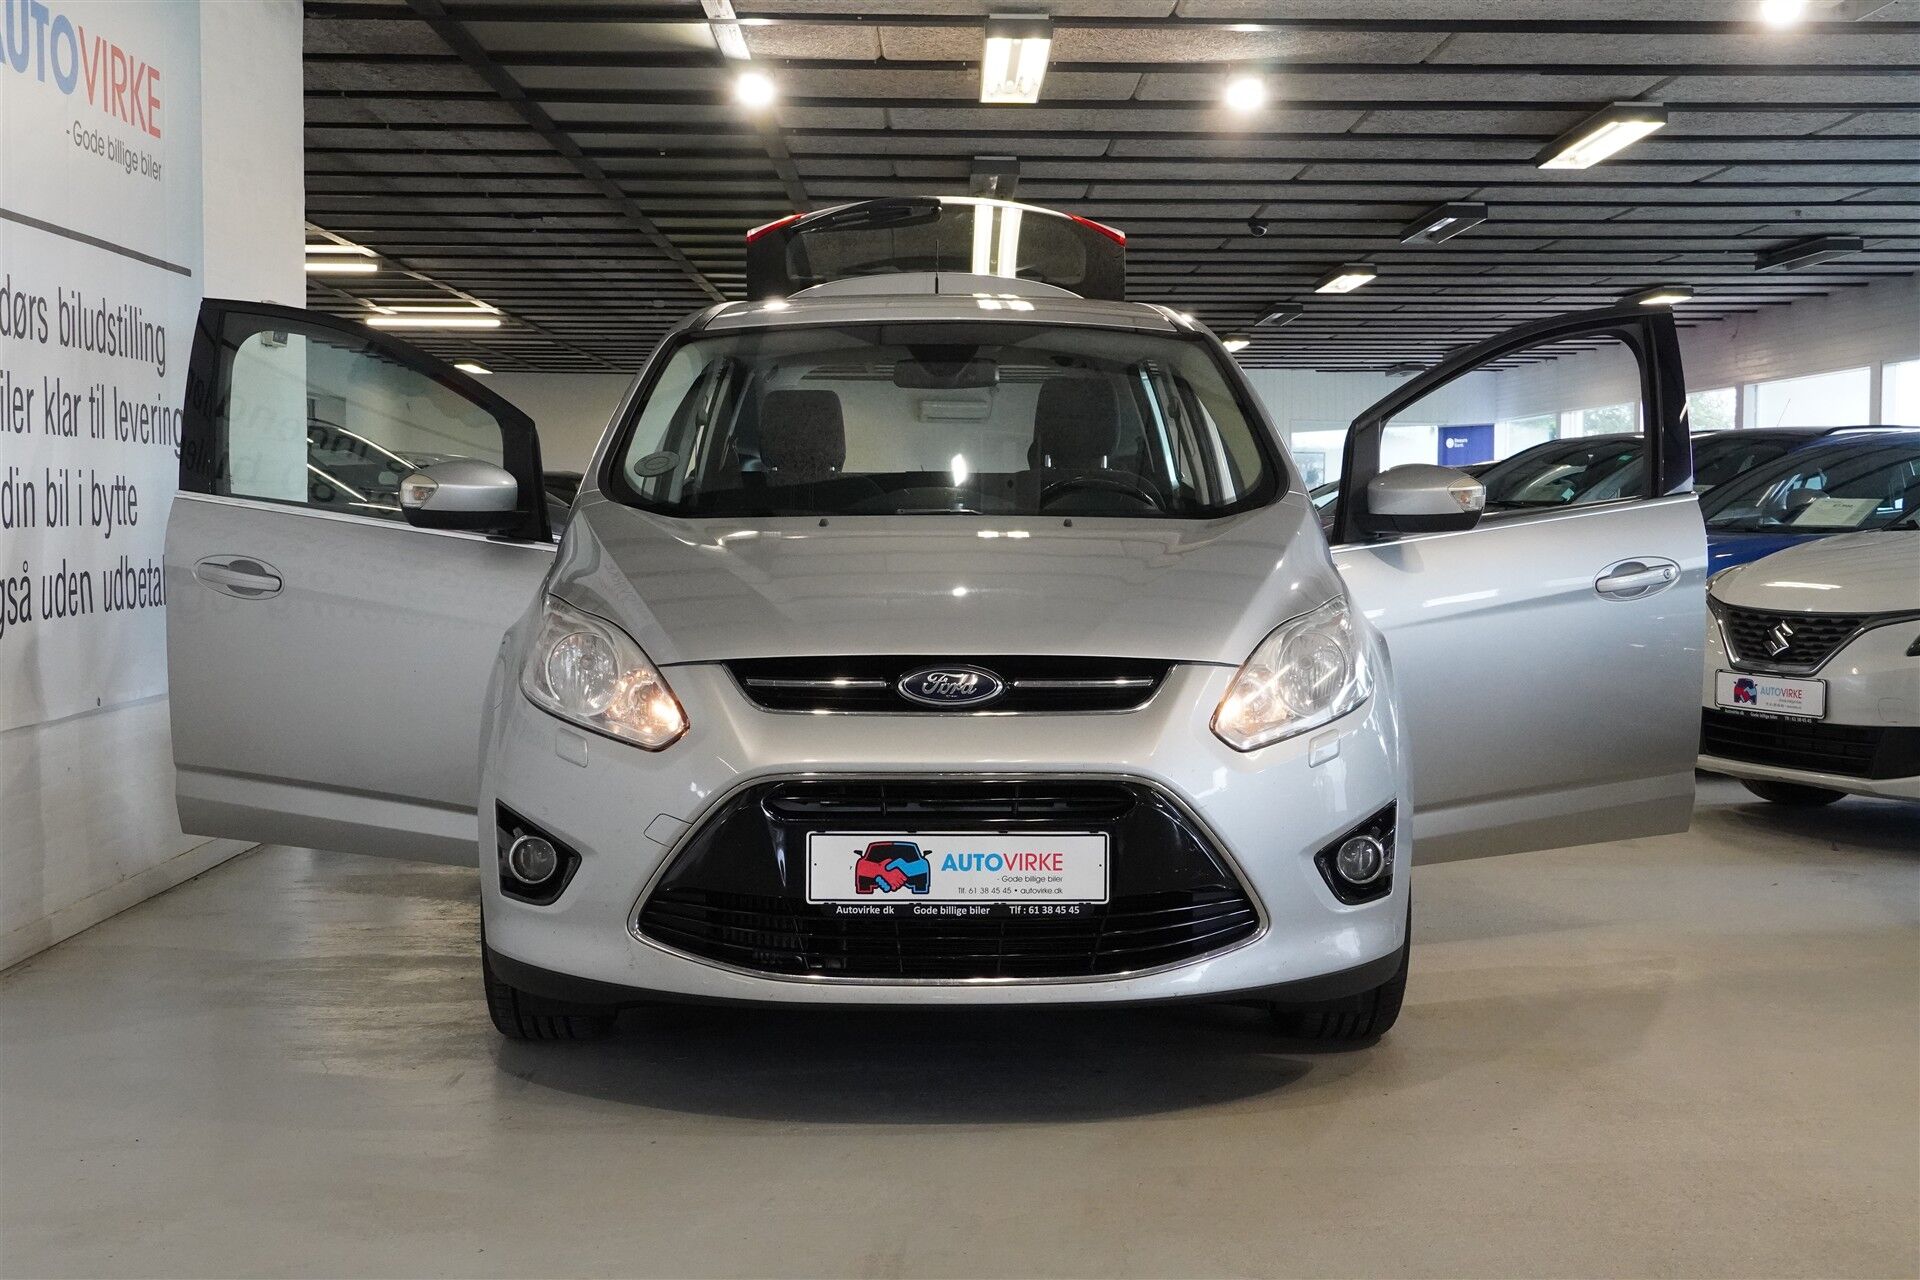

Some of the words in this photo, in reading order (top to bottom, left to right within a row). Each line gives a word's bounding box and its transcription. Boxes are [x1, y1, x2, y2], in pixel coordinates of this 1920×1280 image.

[0, 0, 161, 139] UTOVIRKE
[73, 120, 105, 157] Gode
[107, 135, 139, 175] billige
[141, 150, 162, 182] biler
[0, 273, 49, 344] dørs
[58, 286, 166, 378] biludstilling
[44, 375, 82, 438] klar
[89, 383, 105, 440] til
[114, 386, 184, 460] levering
[2, 466, 36, 529] din
[46, 467, 69, 528] bil
[78, 469, 83, 527] i
[91, 469, 138, 540] bytte
[42, 558, 94, 620] uden
[921, 672, 978, 694] Ford
[1760, 686, 1802, 699] AUTOVIRKE
[941, 853, 1063, 872] AUTOVIRKE
[1001, 875, 1024, 883] Gode
[1025, 875, 1046, 884] billige
[1048, 875, 1063, 883] biler
[836, 905, 880, 915] Autovirke
[882, 905, 895, 915] dk
[913, 905, 938, 915] Gode
[940, 905, 968, 917] billige
[970, 905, 991, 915] biler
[1009, 905, 1022, 915] Tlf
[1028, 905, 1040, 915] 61
[1041, 905, 1053, 915] 38
[1055, 905, 1067, 915] 45
[1068, 905, 1080, 915] 45
[968, 887, 977, 895] 61
[980, 887, 990, 895] 38
[991, 887, 1001, 895] 45
[1003, 887, 1012, 895] 45
